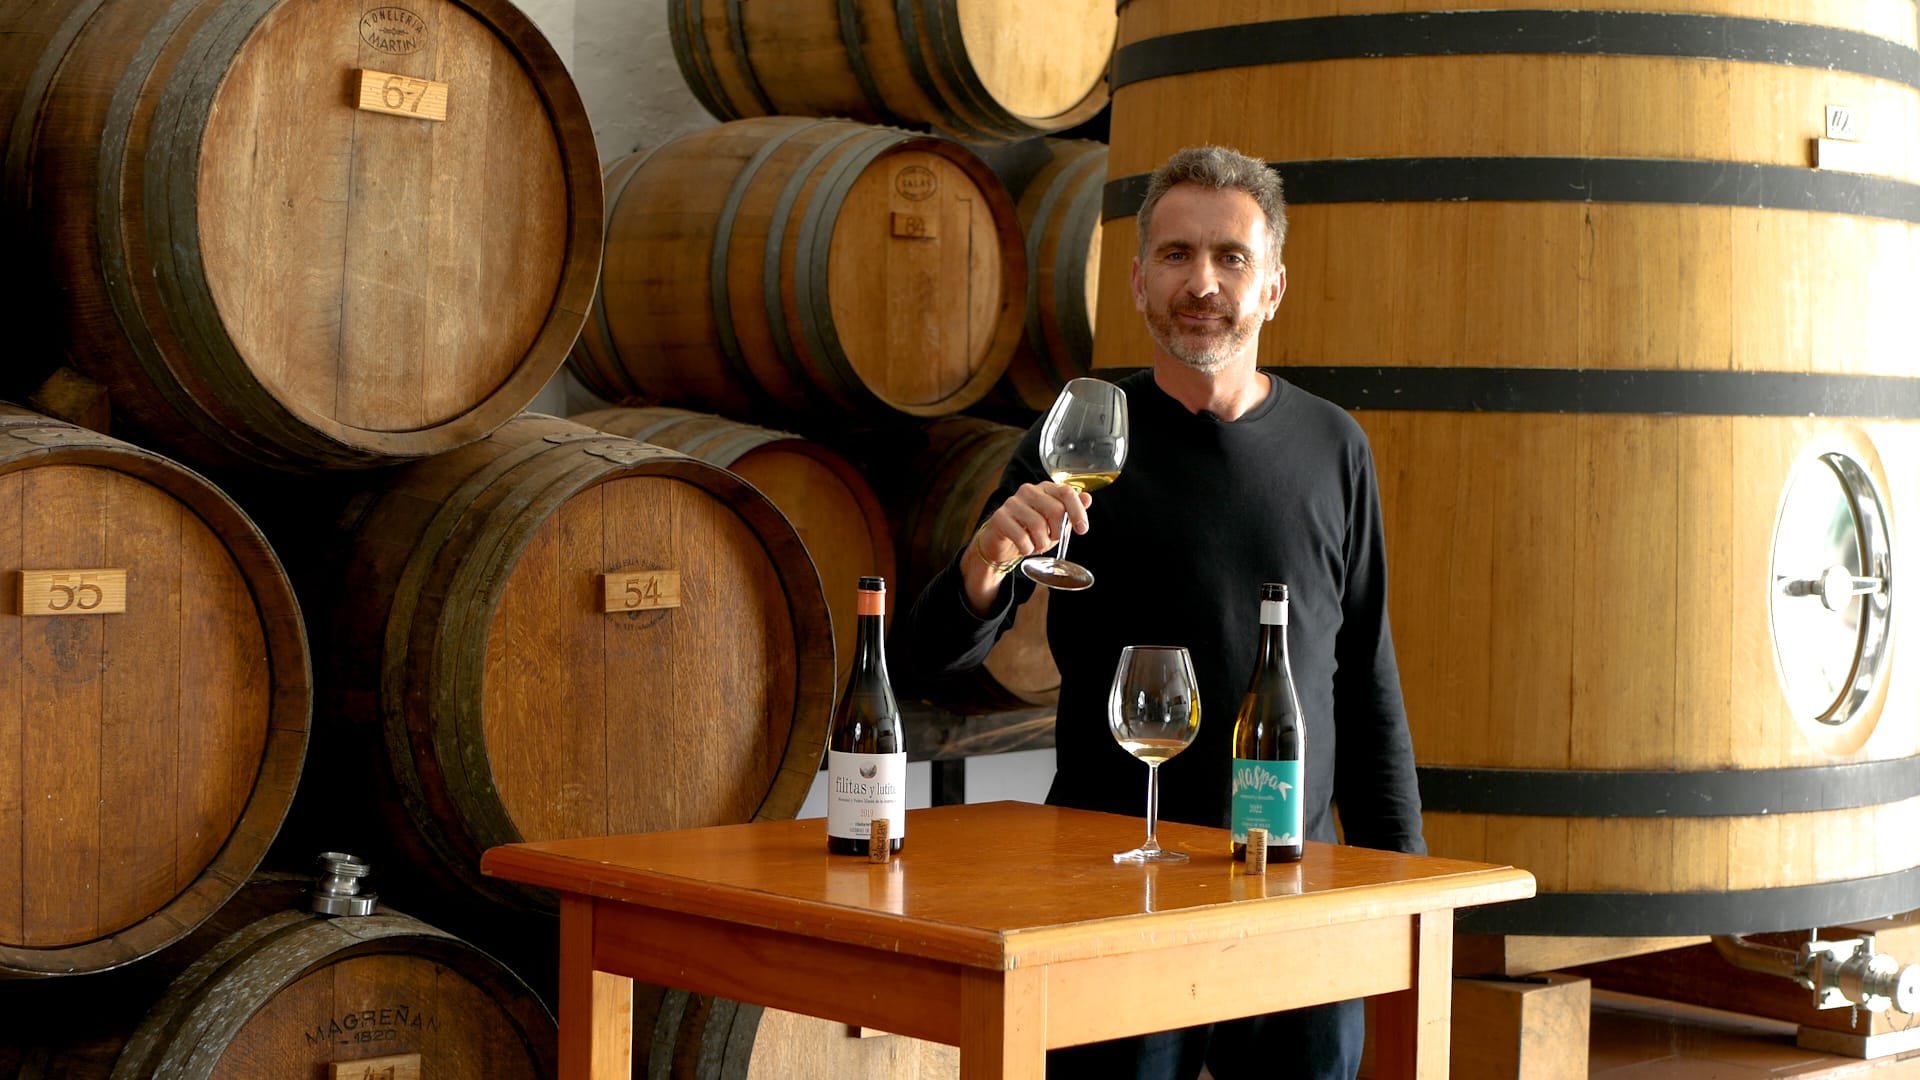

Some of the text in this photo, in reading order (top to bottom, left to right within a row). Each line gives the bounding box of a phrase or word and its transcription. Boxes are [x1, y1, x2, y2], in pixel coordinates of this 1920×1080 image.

[363, 9, 423, 34] TONELERIA
[368, 32, 416, 52] MARTIN
[382, 76, 429, 112] 67
[905, 216, 926, 236] 84
[48, 574, 103, 610] 55
[625, 576, 662, 608] 54
[835, 776, 867, 795] filitas
[869, 785, 876, 798] y
[860, 807, 874, 818] 2019
